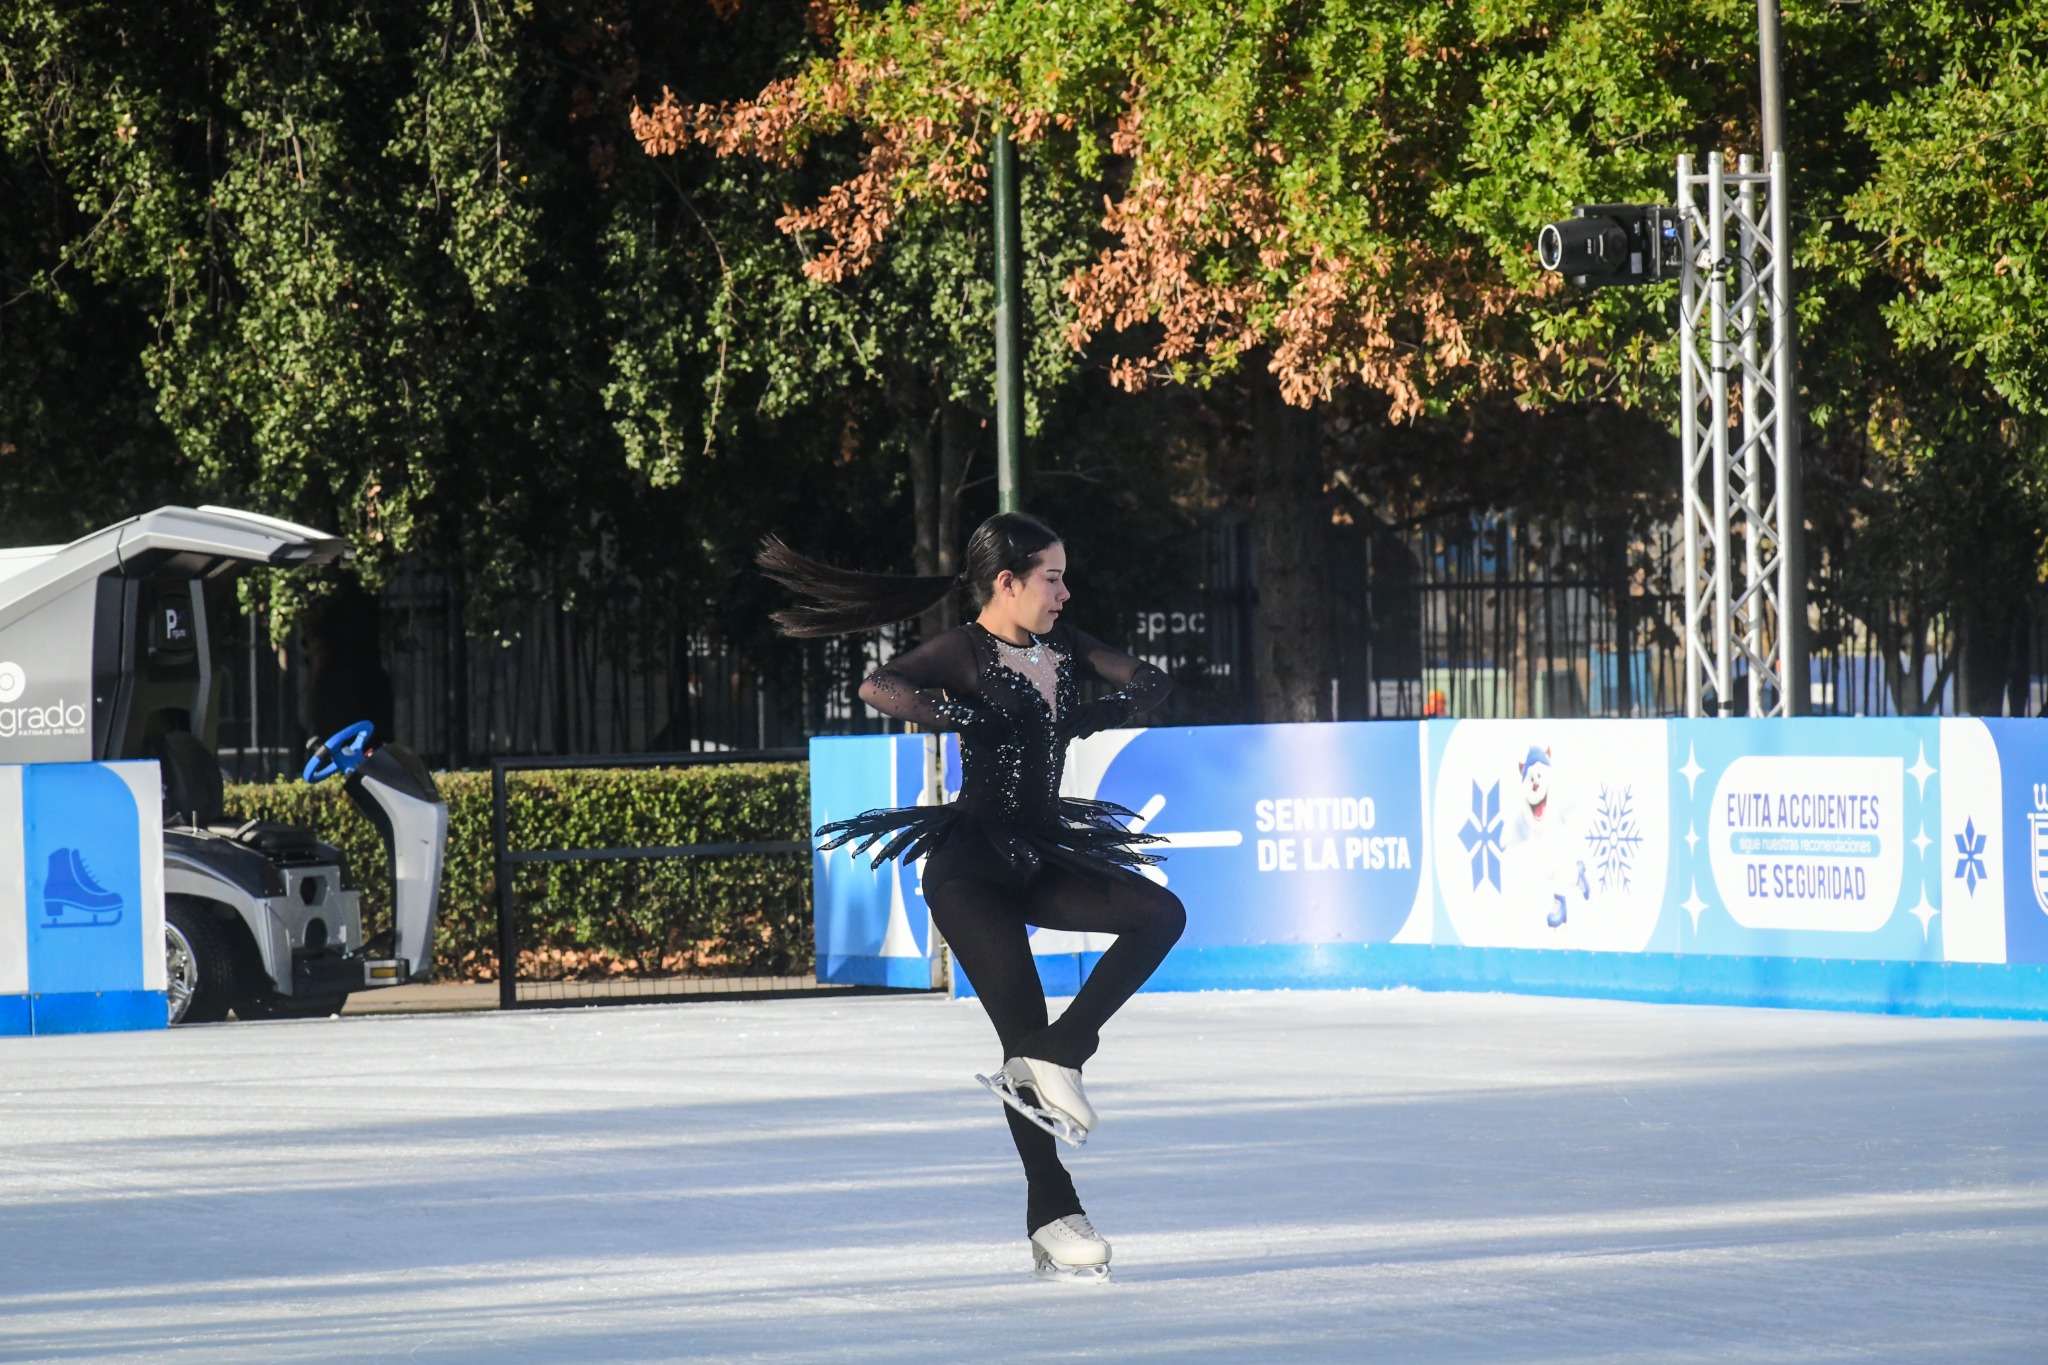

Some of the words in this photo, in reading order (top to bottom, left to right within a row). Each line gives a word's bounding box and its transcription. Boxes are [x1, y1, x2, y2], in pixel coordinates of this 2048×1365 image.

[1255, 797, 1376, 832] SENTIDO
[1727, 793, 1772, 828] EVITA
[1777, 793, 1879, 830] ACCIDENTES
[1257, 838, 1297, 872] DE
[1303, 837, 1341, 871] LA
[1346, 836, 1412, 870] PISTA
[1747, 863, 1768, 898] DE
[1773, 863, 1866, 900] SEGURIDAD
